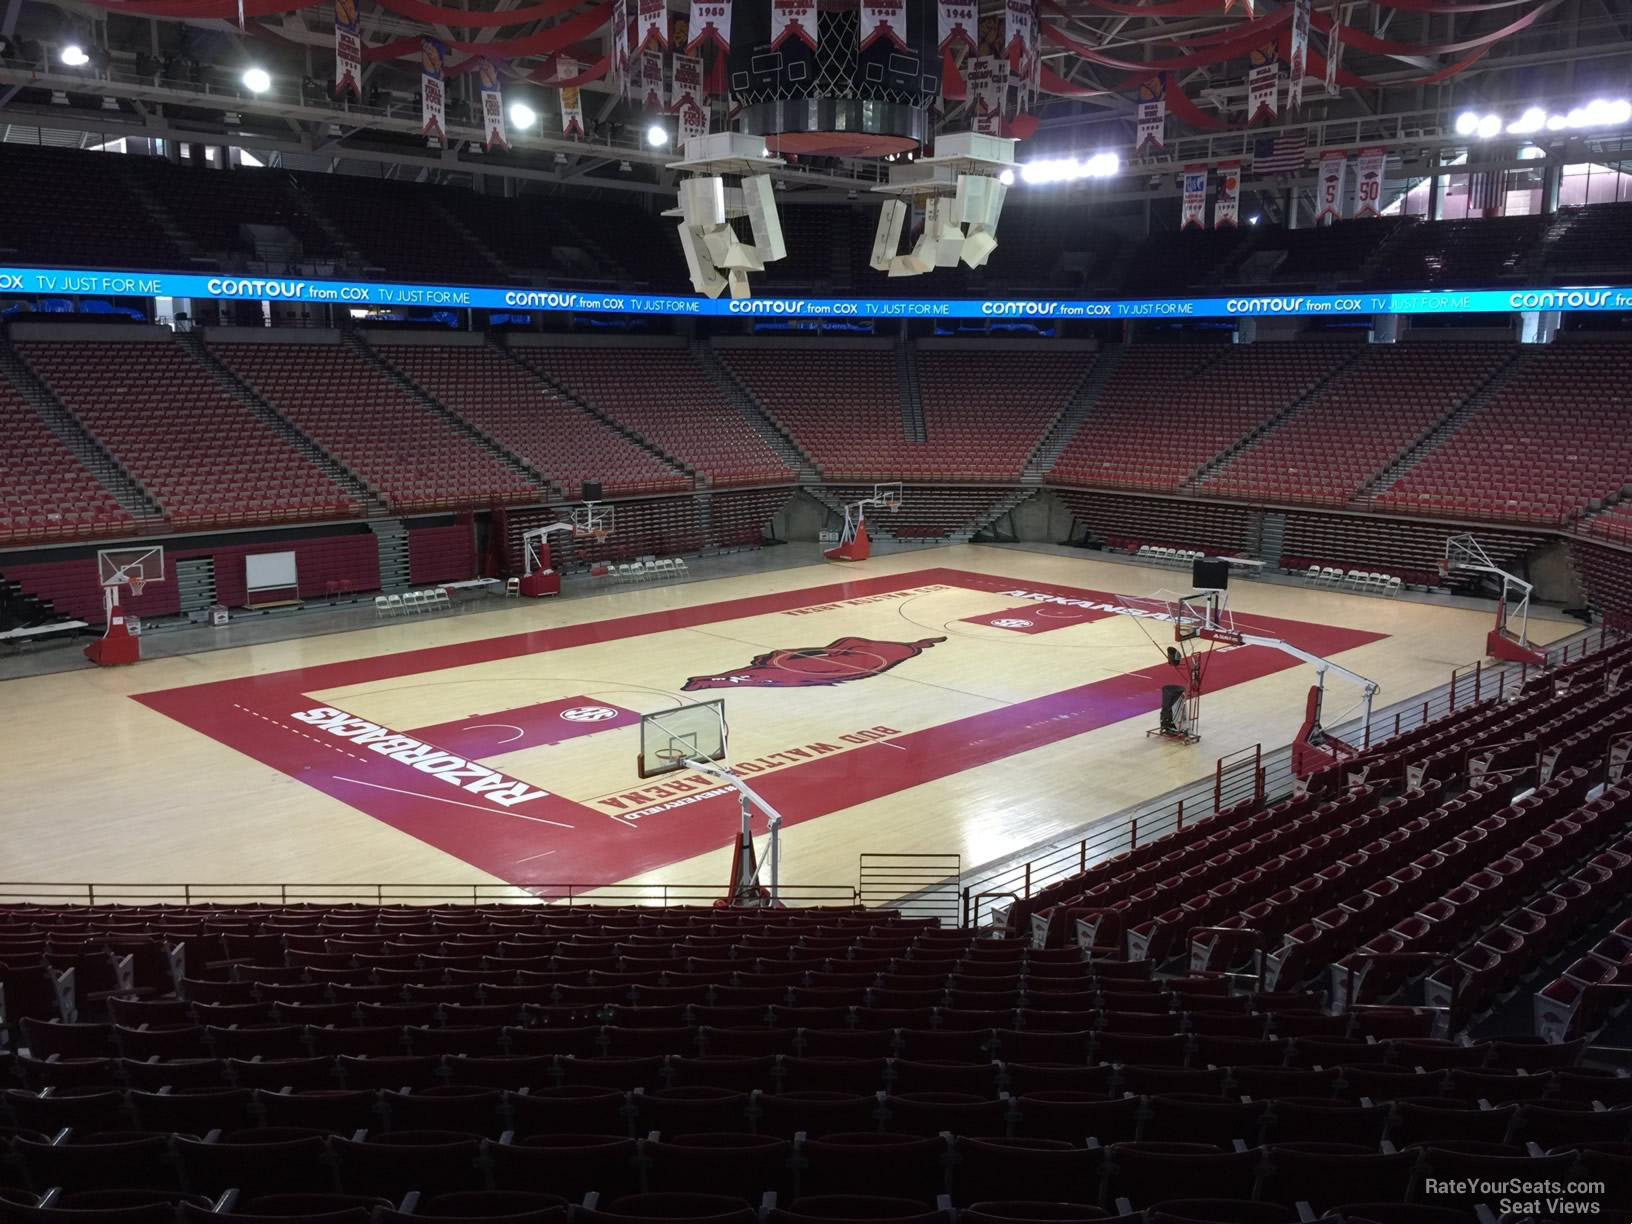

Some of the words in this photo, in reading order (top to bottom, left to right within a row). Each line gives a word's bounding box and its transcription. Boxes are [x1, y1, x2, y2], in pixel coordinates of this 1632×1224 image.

[946, 9, 972, 19] 1944
[1326, 185, 1336, 203] 5
[1359, 181, 1379, 201] 50
[36, 275, 56, 289] TV
[61, 276, 98, 292] JUST
[103, 278, 135, 292] FOR
[139, 279, 162, 293] ME
[207, 279, 305, 297] CONTOUR
[309, 285, 338, 300] from
[341, 287, 370, 301] COX
[378, 288, 394, 302] TV
[395, 289, 424, 303] JUST
[427, 290, 452, 304] FOR
[454, 291, 470, 304] ME
[505, 291, 577, 308] CONTOUR
[579, 297, 601, 309] from
[602, 298, 625, 309] COX
[631, 298, 643, 310] TV
[644, 299, 665, 311] JUST
[667, 300, 685, 311] FOR
[686, 300, 700, 311] ME
[729, 300, 805, 314] CONTOUR
[807, 303, 831, 314] from
[833, 303, 858, 314] COX
[865, 303, 880, 314] TV
[881, 303, 907, 315] JUST
[909, 304, 931, 314] FOR
[933, 304, 949, 315] ME
[982, 301, 1058, 315] CONTOUR
[1060, 304, 1084, 315] from
[1086, 304, 1111, 315] COX
[1118, 303, 1130, 314] TV
[1131, 303, 1154, 315] JUST
[1156, 303, 1177, 314] FOR
[1179, 302, 1193, 314] ME
[1227, 297, 1303, 313] CONTOUR
[1306, 299, 1332, 311] from
[1334, 298, 1361, 311] COX
[1371, 298, 1387, 310] TV
[1388, 297, 1418, 310] JUST
[1421, 297, 1449, 309] FOR
[1452, 296, 1471, 309] ME
[1509, 292, 1612, 308] CONTOUR
[838, 725, 902, 744] BUD
[291, 707, 549, 807] RAZORBACKS
[598, 774, 714, 809] ARENA
[624, 785, 737, 819] #NEVERYIELD
